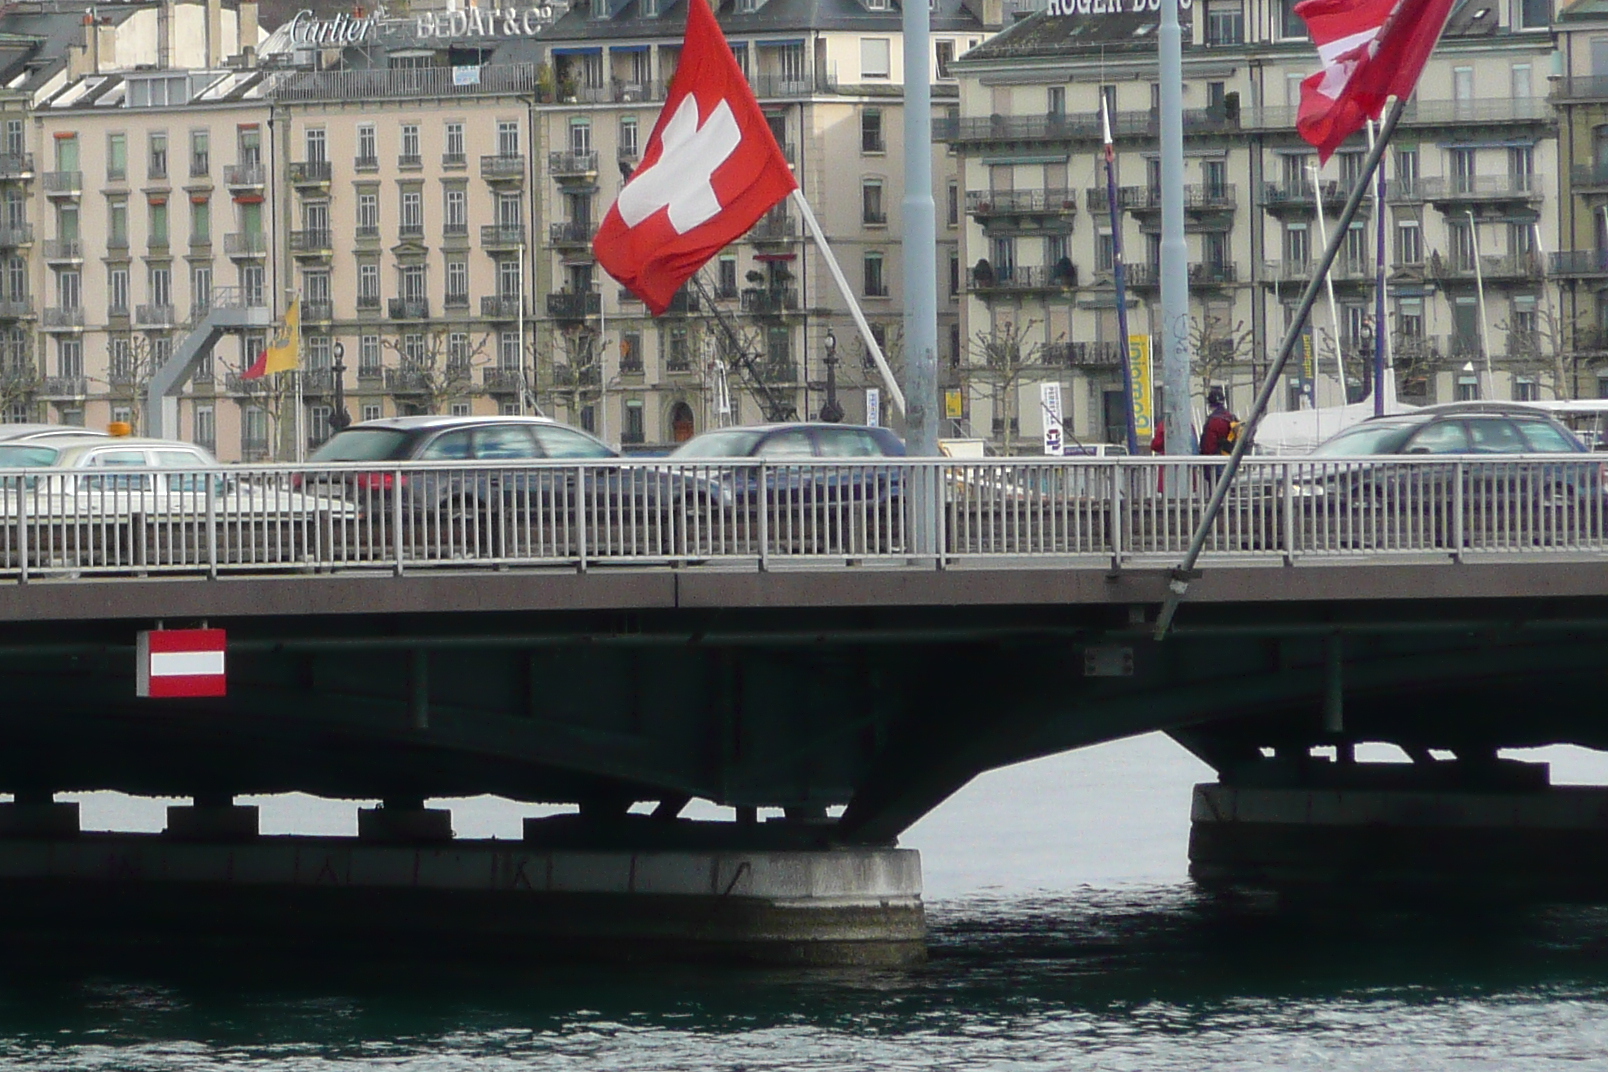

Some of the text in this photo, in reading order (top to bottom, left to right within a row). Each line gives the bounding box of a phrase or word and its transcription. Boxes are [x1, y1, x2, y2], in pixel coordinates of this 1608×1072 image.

[290, 9, 375, 42] Cartier
[416, 6, 499, 38] BEDAT
[503, 7, 521, 35] &
